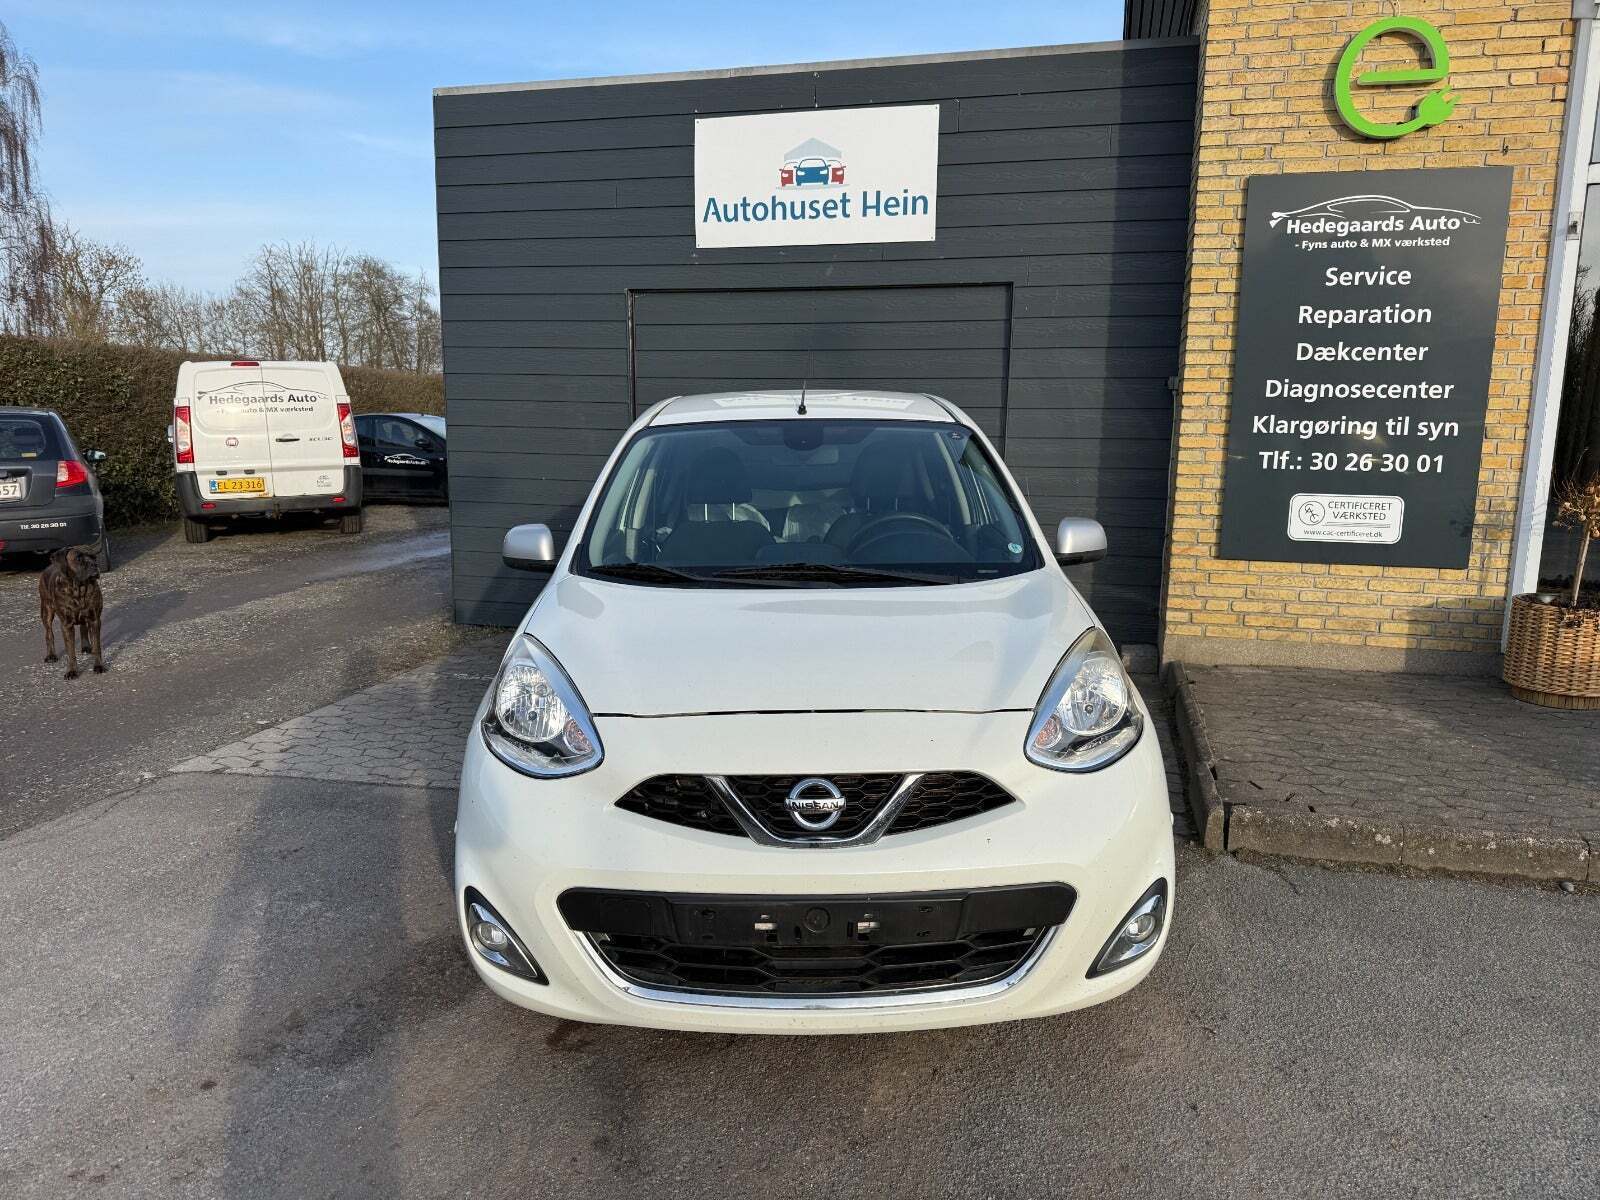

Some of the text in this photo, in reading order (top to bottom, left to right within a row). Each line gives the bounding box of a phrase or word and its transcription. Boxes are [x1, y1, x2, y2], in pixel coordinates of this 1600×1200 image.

[703, 189, 929, 223] Autohuset Hein
[1286, 215, 1461, 237] Hedegaards Auto
[1301, 240, 1328, 251] Fyns
[1331, 239, 1357, 249] auto
[1360, 238, 1369, 248] &
[1372, 237, 1392, 248] MX
[1395, 236, 1451, 247] værksted
[1325, 265, 1412, 287] Service
[1298, 304, 1432, 328] Reparation
[1296, 342, 1429, 362] Dækcenter
[1265, 378, 1455, 402] Diagnosecenter
[208, 393, 318, 406] Hedegaards Auto
[1252, 415, 1460, 441] Klargøring til syn
[1258, 451, 1444, 473] Tlf.: 30 26 30 01
[0, 484, 18, 496] 57
[217, 480, 263, 490] EL 23 316
[1327, 501, 1393, 511] CERTIFICERET
[1332, 511, 1387, 521] VÆRKSTED
[1303, 529, 1383, 538] www.cac-certificeret.dk
[791, 801, 839, 810] NISSAN
